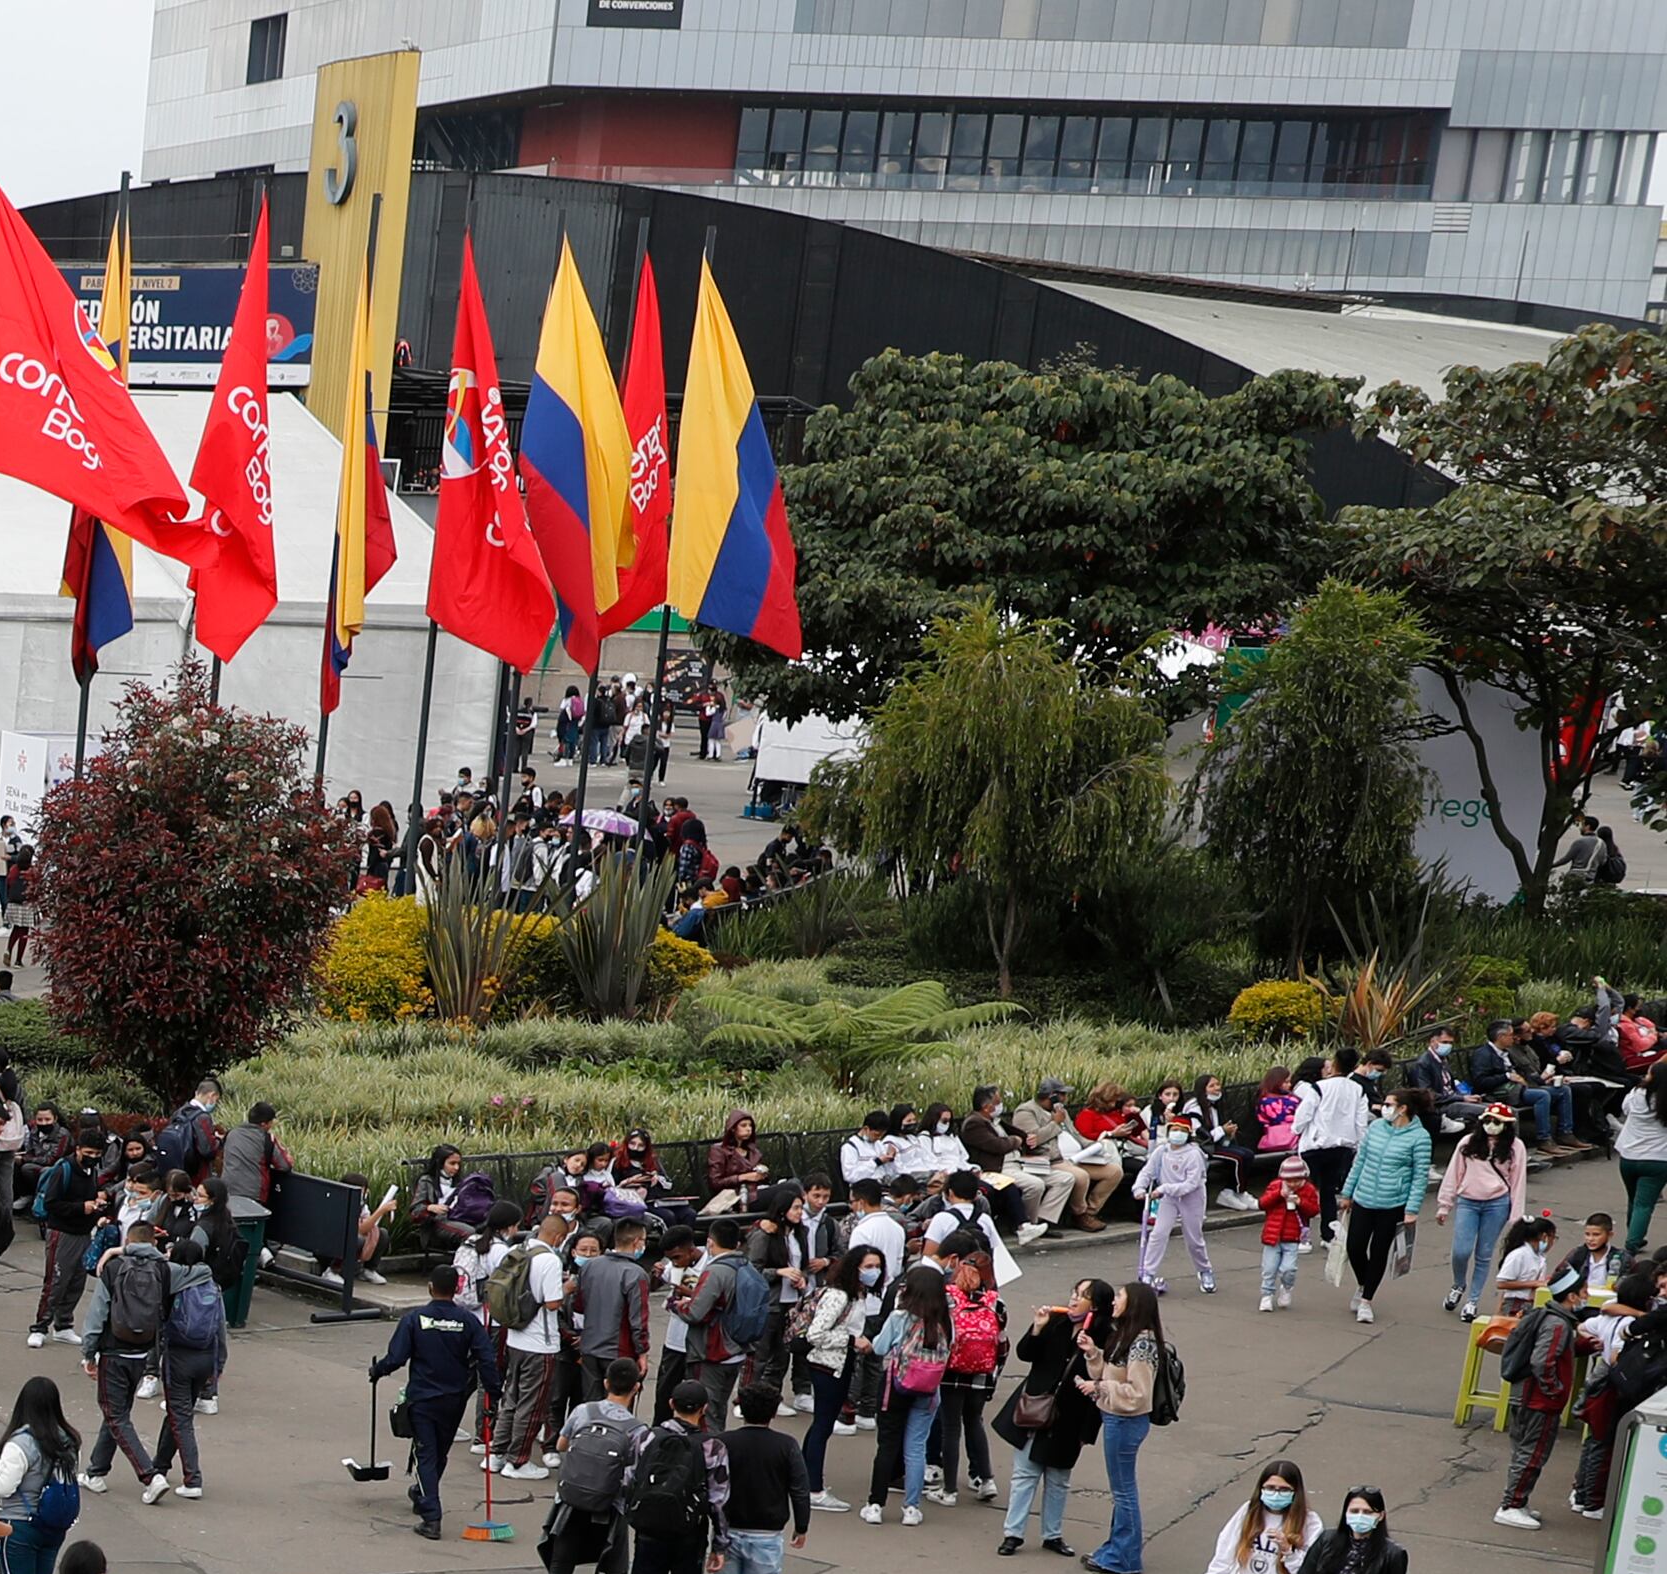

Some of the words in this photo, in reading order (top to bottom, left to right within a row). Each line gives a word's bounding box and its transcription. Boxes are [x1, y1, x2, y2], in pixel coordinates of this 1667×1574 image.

[323, 100, 358, 206] 3
[142, 278, 166, 290] NIVEL
[78, 294, 161, 324] EDÓN
[128, 326, 234, 351] ERSITARIA
